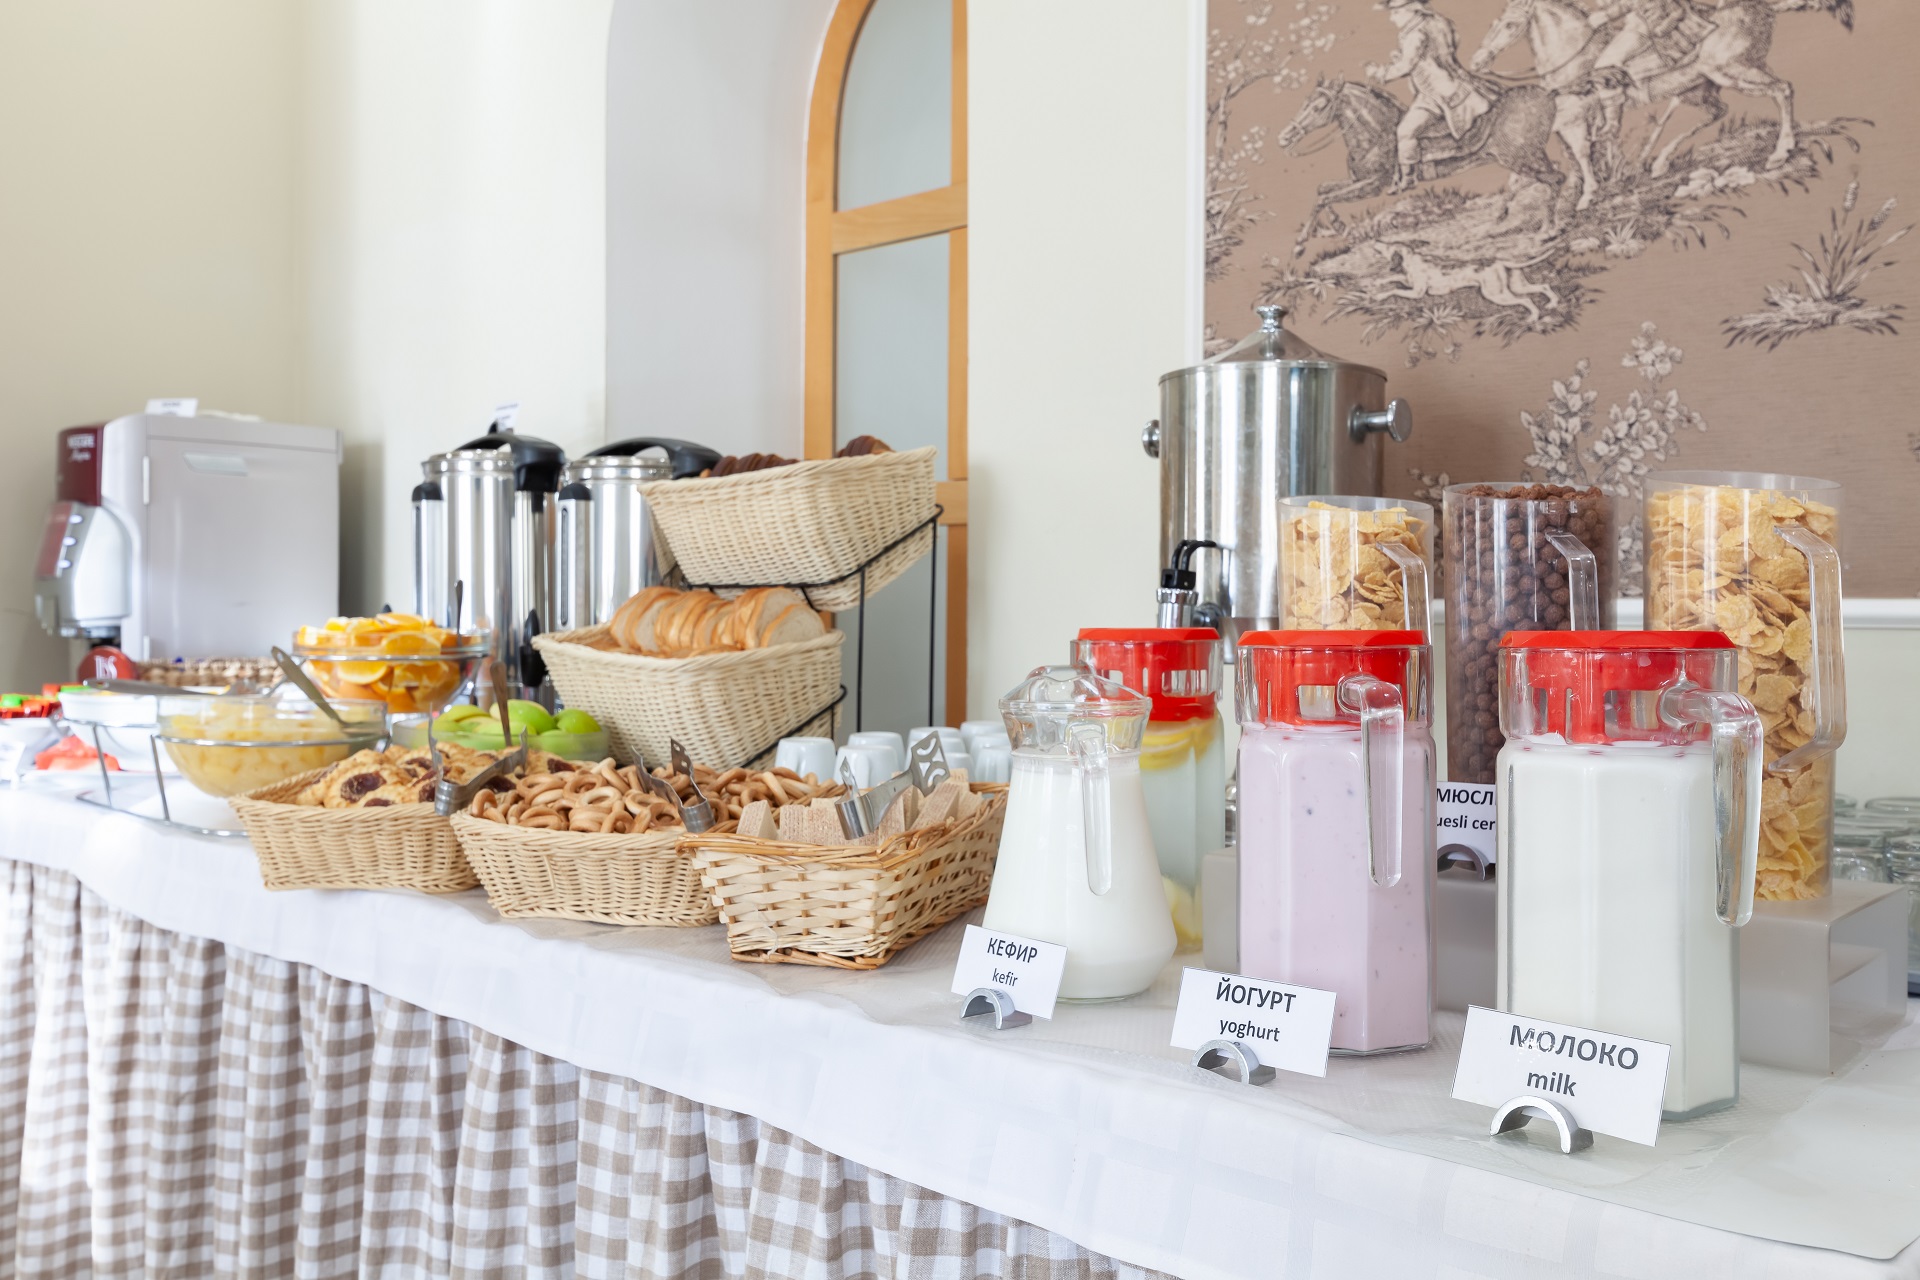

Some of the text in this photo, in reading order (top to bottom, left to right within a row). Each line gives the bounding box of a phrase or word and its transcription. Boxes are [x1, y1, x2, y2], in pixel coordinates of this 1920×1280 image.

[1436, 788, 1496, 806] МЮСЛ
[1436, 815, 1496, 831] uesli cer
[987, 937, 1038, 963] КЕФИР
[992, 967, 1018, 987] kefir
[1215, 977, 1297, 1012] ЙОГУРТ
[1219, 1019, 1281, 1042] yoghurt
[1509, 1024, 1639, 1070] МОЛОКО
[1526, 1071, 1577, 1097] milk
